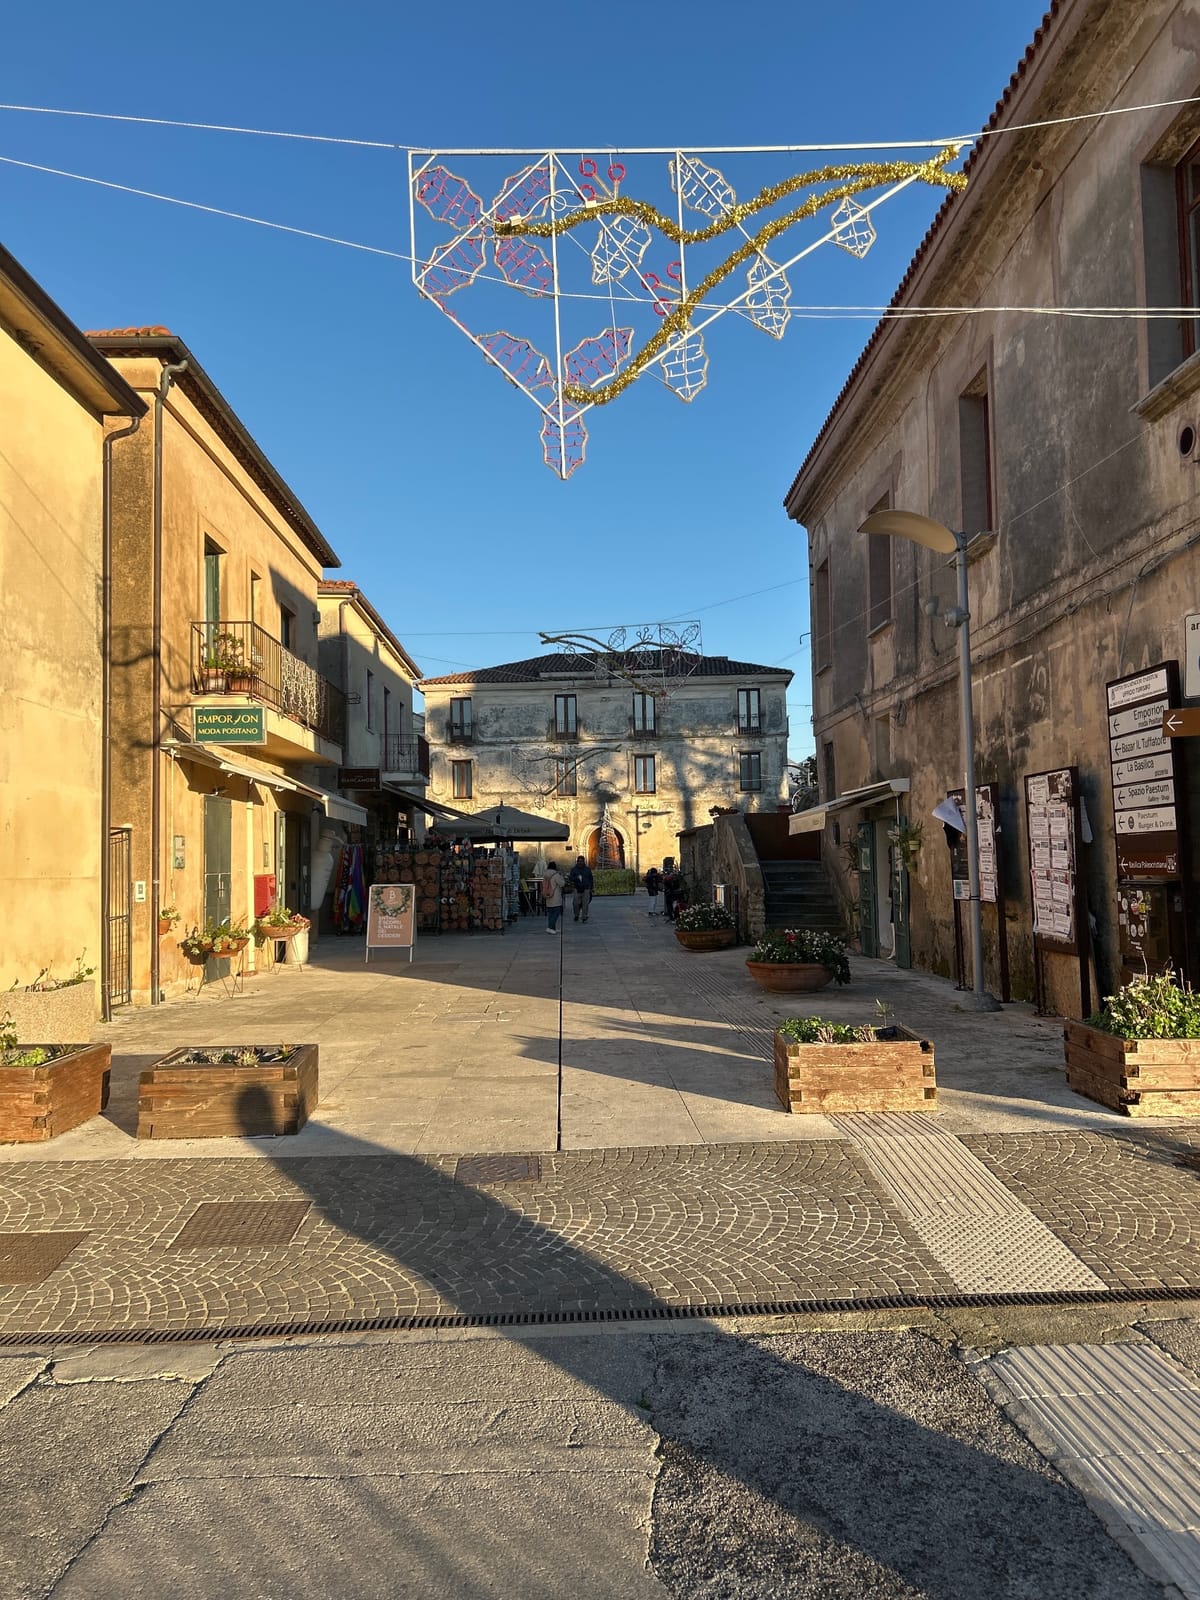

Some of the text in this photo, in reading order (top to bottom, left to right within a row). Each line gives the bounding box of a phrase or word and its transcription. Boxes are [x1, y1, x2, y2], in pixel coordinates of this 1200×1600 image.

[1133, 704, 1165, 721] Emporion
[222, 727, 258, 735] POSITANO
[1121, 741, 1135, 753] Bazar
[1141, 736, 1167, 749] Tuffatore
[1126, 759, 1154, 772] La Basilica
[1128, 783, 1170, 799] Spazio Paestum
[1138, 821, 1154, 830] Burger
[1159, 820, 1173, 828] Drink
